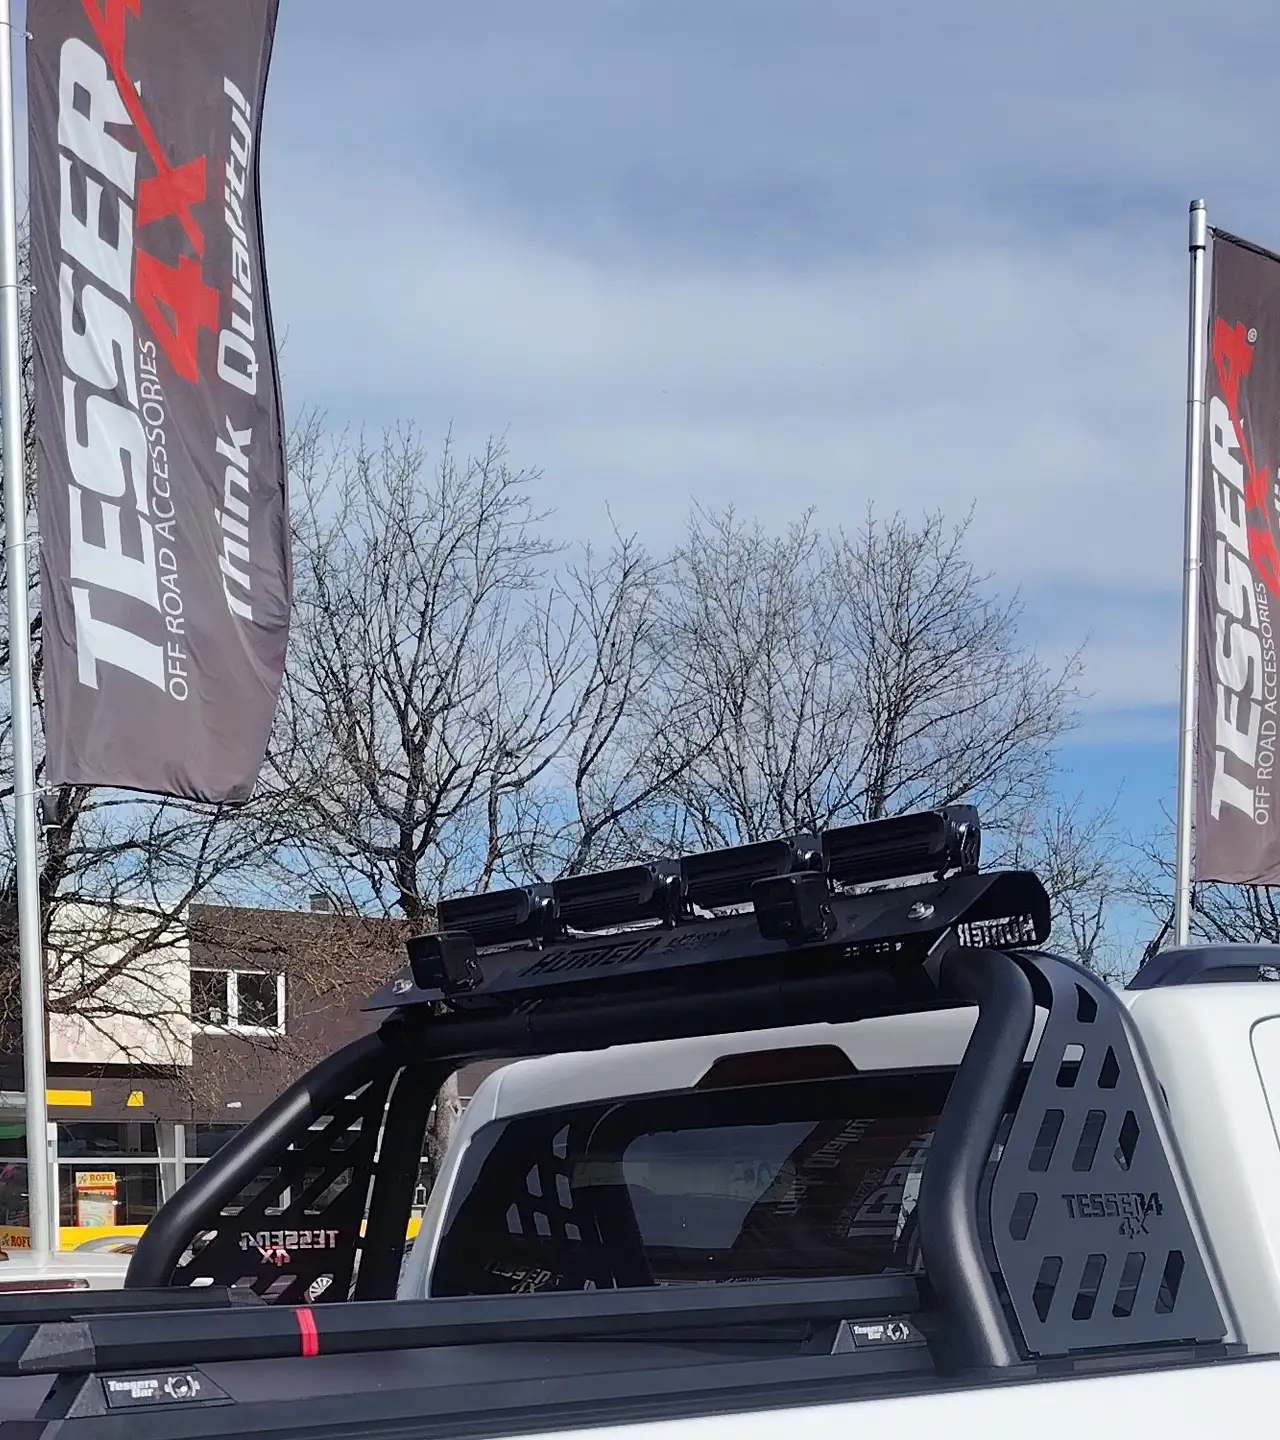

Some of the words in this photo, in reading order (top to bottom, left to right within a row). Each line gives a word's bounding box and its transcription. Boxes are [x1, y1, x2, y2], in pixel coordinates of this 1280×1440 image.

[217, 75, 258, 396] Quality!
[58, 0, 166, 692] TESSER
[138, 338, 176, 542] ACCESSORIES
[214, 414, 253, 621] Think
[159, 547, 185, 636] ROAD
[169, 641, 188, 701] OFF
[1255, 582, 1277, 715] ACCESSORIES
[1256, 719, 1277, 780] ROAD
[1255, 784, 1270, 826] OFF
[89, 1173, 114, 1182] ROFU
[107, 1378, 158, 1391] Tessera
